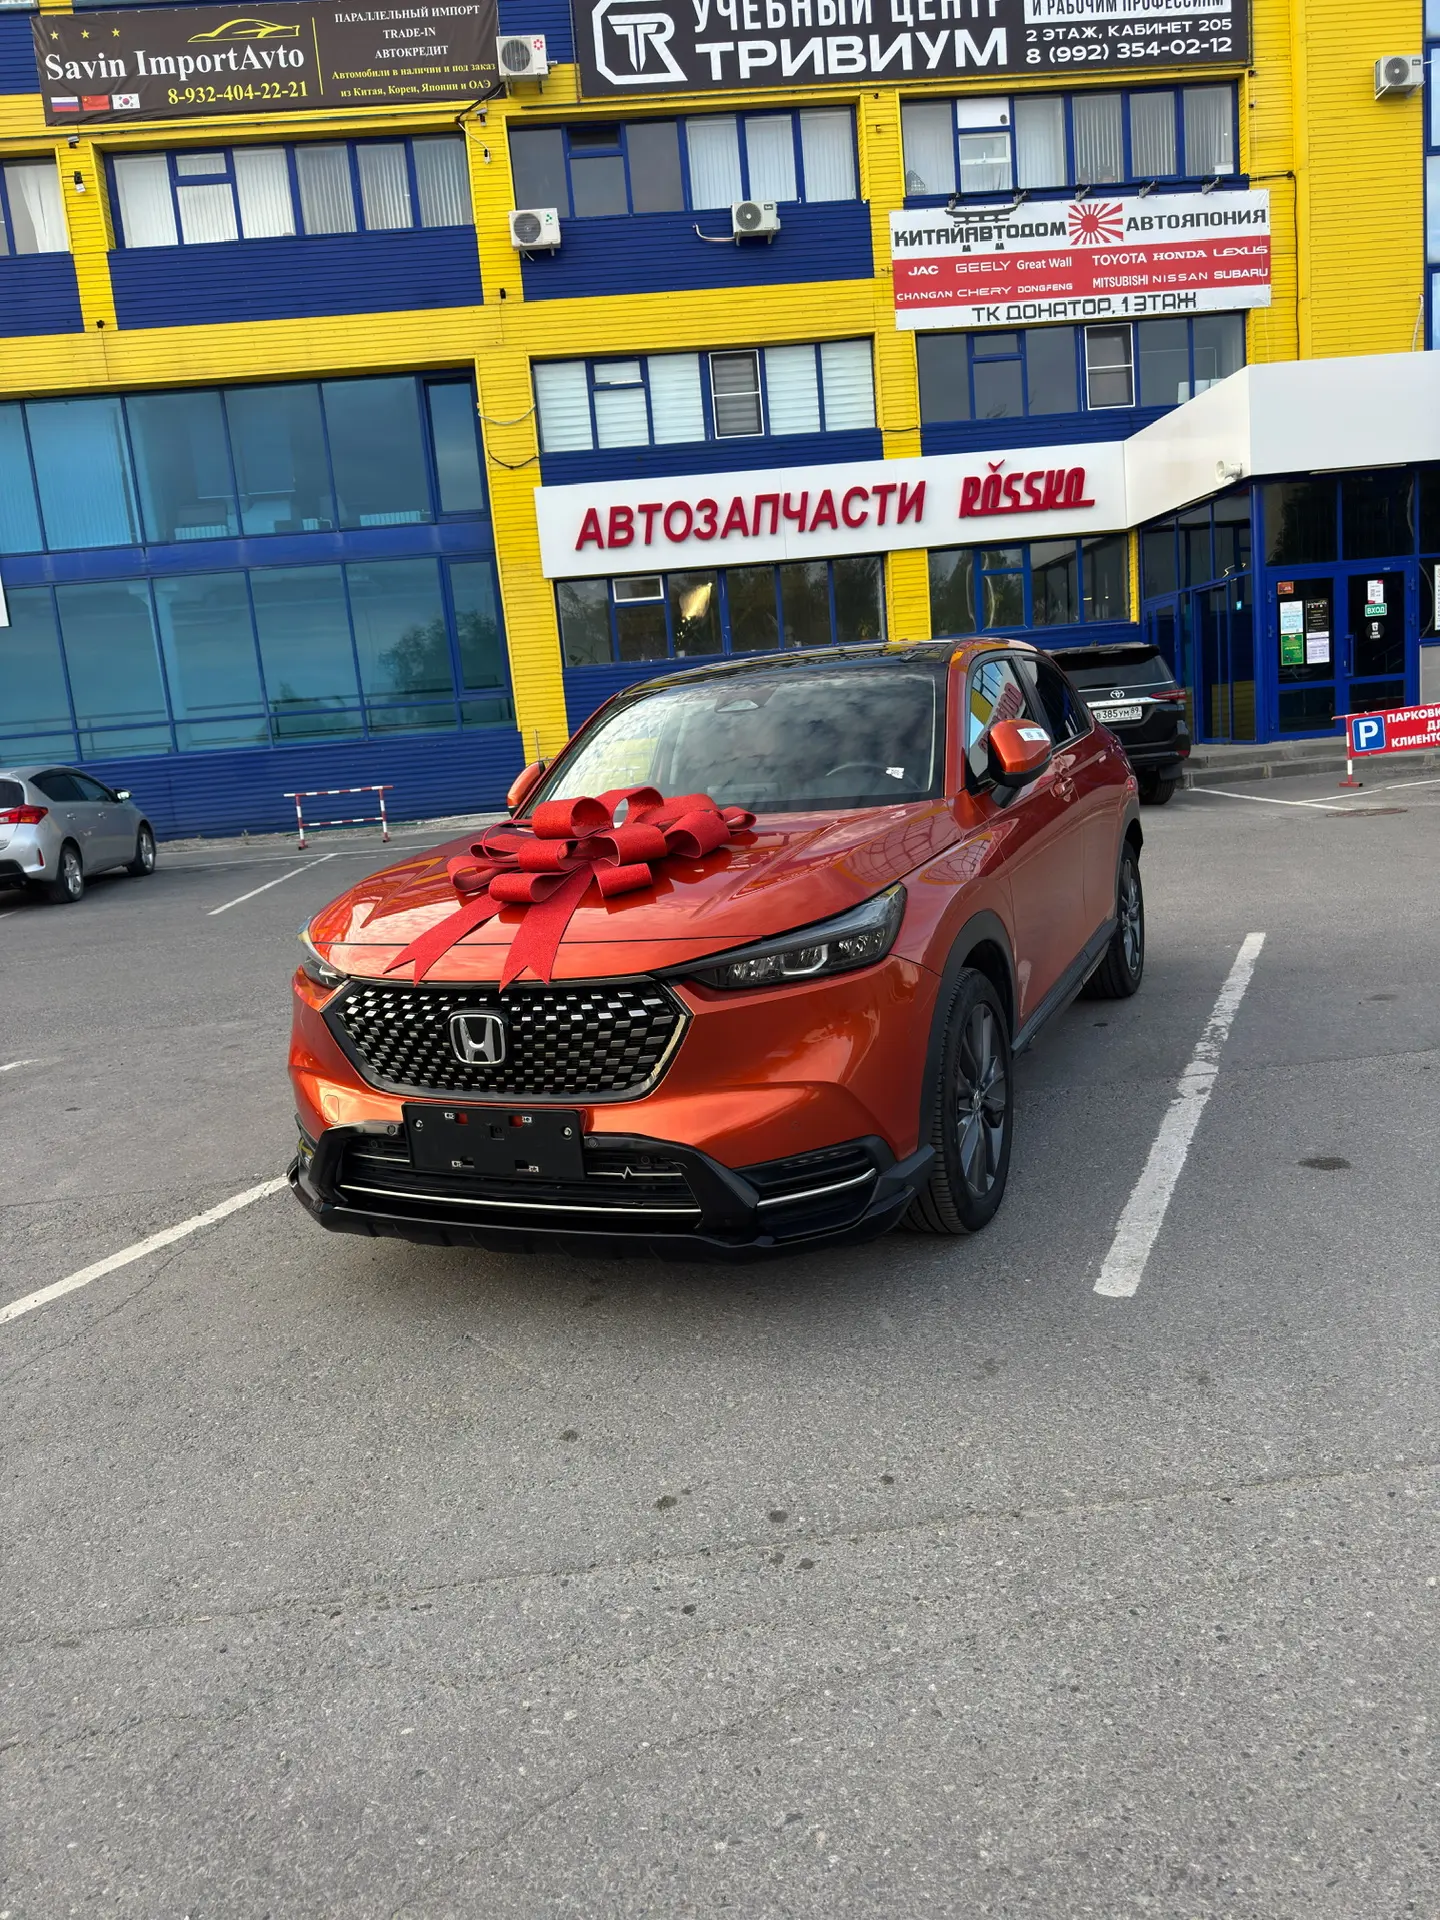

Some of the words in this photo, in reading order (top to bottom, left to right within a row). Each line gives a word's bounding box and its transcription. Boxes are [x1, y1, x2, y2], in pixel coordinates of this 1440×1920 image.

[334, 7, 429, 23] ПАРАЛЛЕЛЬНЫЙ
[431, 5, 480, 17] ИМПОРТ
[1032, 0, 1042, 16] И
[1047, 0, 1117, 15] РАБОЧИМ
[383, 27, 436, 39] TRADE-IN
[1026, 30, 1037, 42] 2
[1043, 26, 1103, 42] ЭТАЖ,
[1108, 21, 1193, 37] КАБИНЕТ
[1199, 18, 1232, 32] 205
[375, 45, 448, 59] АВТОКРЕДИТ
[695, 27, 1008, 81] ТРИВИУМ
[1026, 48, 1041, 64] 8
[1049, 44, 1109, 64] (992)
[1117, 37, 1232, 59] 354-02-12
[45, 52, 127, 81] Savin
[133, 44, 305, 81] ImportAvto
[332, 67, 390, 80] Автомобили
[400, 66, 442, 76] наличии
[443, 65, 450, 73] и
[452, 64, 469, 73] под
[471, 63, 496, 71] заказ
[167, 80, 309, 105] 8-932-404-22-21
[340, 89, 352, 97] из
[353, 86, 386, 97] Китая,
[388, 84, 420, 96] Кореи,
[422, 82, 458, 92] Японии
[469, 79, 491, 89] ОАЭ
[1126, 209, 1267, 232] АВТОЯПОНИЯ
[1092, 252, 1147, 266] TOYOTA
[1152, 249, 1207, 261] HONDA
[1213, 245, 1268, 257] LEXUS
[908, 265, 939, 276] JAC
[955, 260, 1011, 274] GEELY
[1016, 258, 1046, 270] Great
[1048, 257, 1073, 268] Wall
[1092, 274, 1148, 288] MITSUBISHI
[1152, 271, 1208, 283] NISSAN
[1213, 268, 1269, 280] SUBARU
[896, 290, 953, 301] CHANGAN
[957, 286, 1012, 297] CHERY
[1017, 283, 1073, 294] DONGFENG
[972, 306, 1001, 322] ТК
[1006, 298, 1116, 321] ДОНАТОР,
[575, 480, 927, 551] АВТОЗАПЧАСТИ
[1367, 606, 1385, 615] ВХОД
[1387, 707, 1440, 724] ПАРКОВК
[1358, 720, 1379, 748] P
